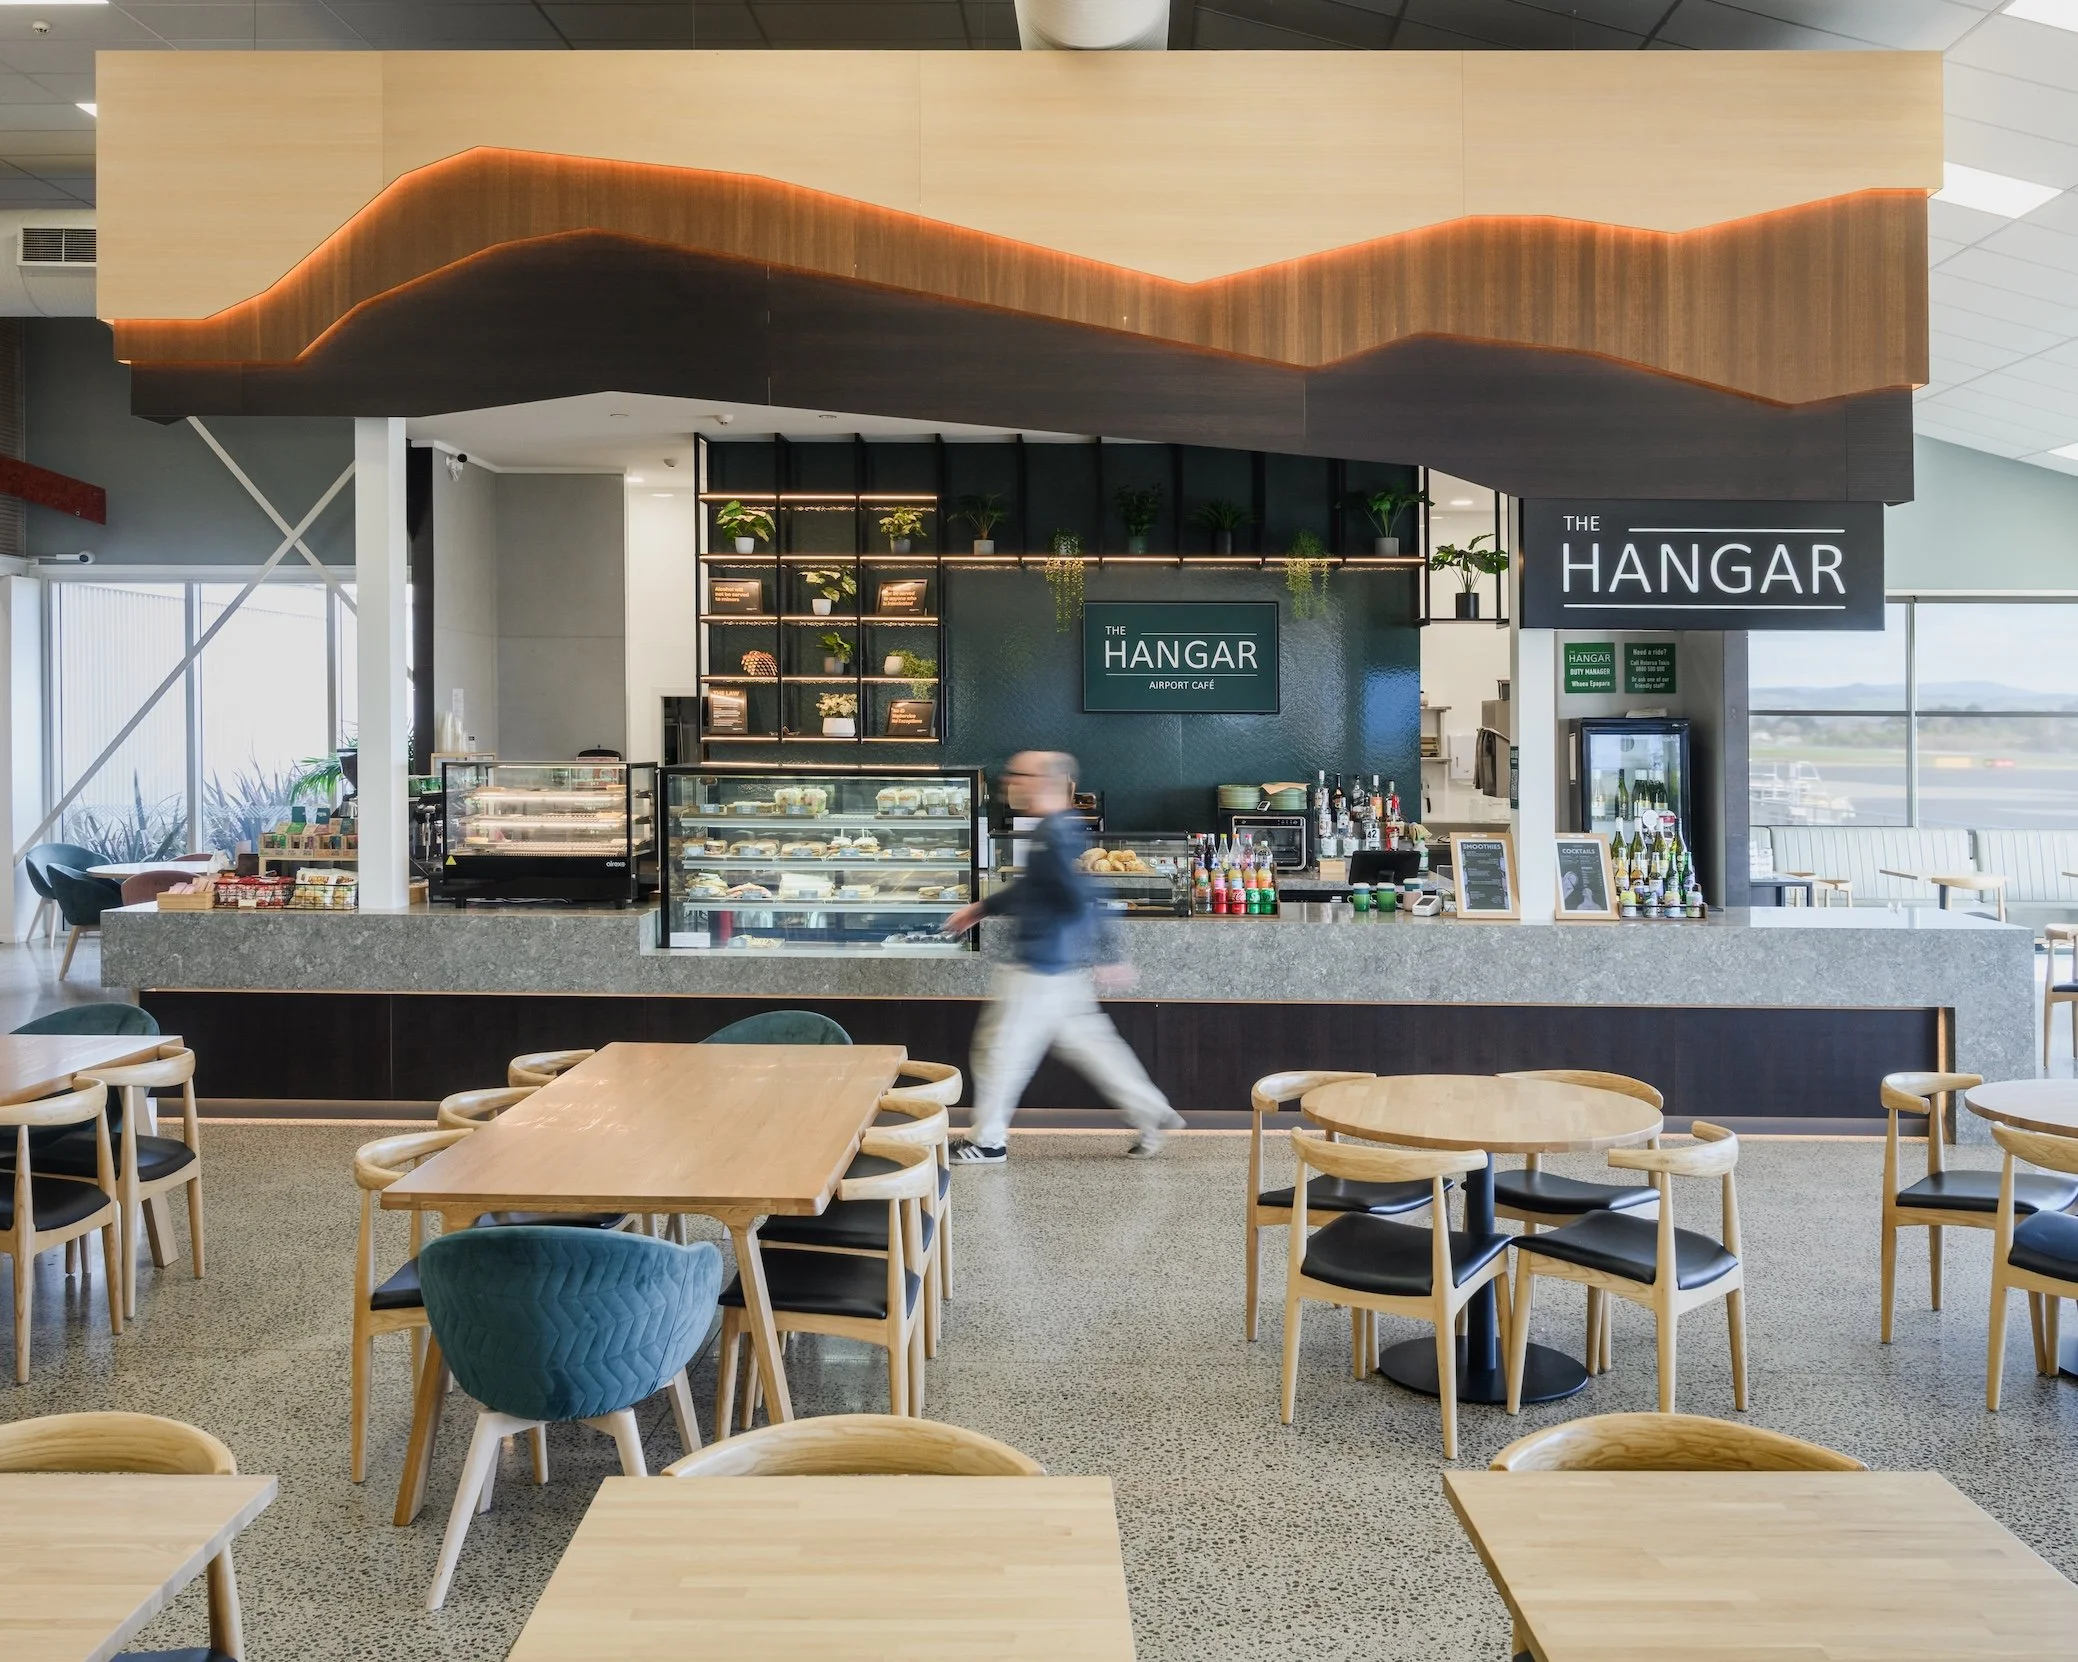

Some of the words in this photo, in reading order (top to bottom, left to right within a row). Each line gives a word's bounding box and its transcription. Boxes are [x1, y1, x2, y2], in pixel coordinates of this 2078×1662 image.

[1563, 516, 1600, 531] THE
[1562, 543, 1846, 595] HANGAR
[1105, 626, 1126, 636] THE
[1105, 640, 1258, 669] HANGAR
[1632, 648, 1647, 656] Need
[1652, 648, 1667, 656] ride?
[1569, 654, 1611, 663] HANGAR
[1570, 668, 1584, 676] DUTY
[1584, 667, 1611, 675] MANAGER
[1149, 681, 1189, 690] AIRPORT
[1191, 678, 1215, 690] CAFÉ
[1367, 829, 1378, 840] 42
